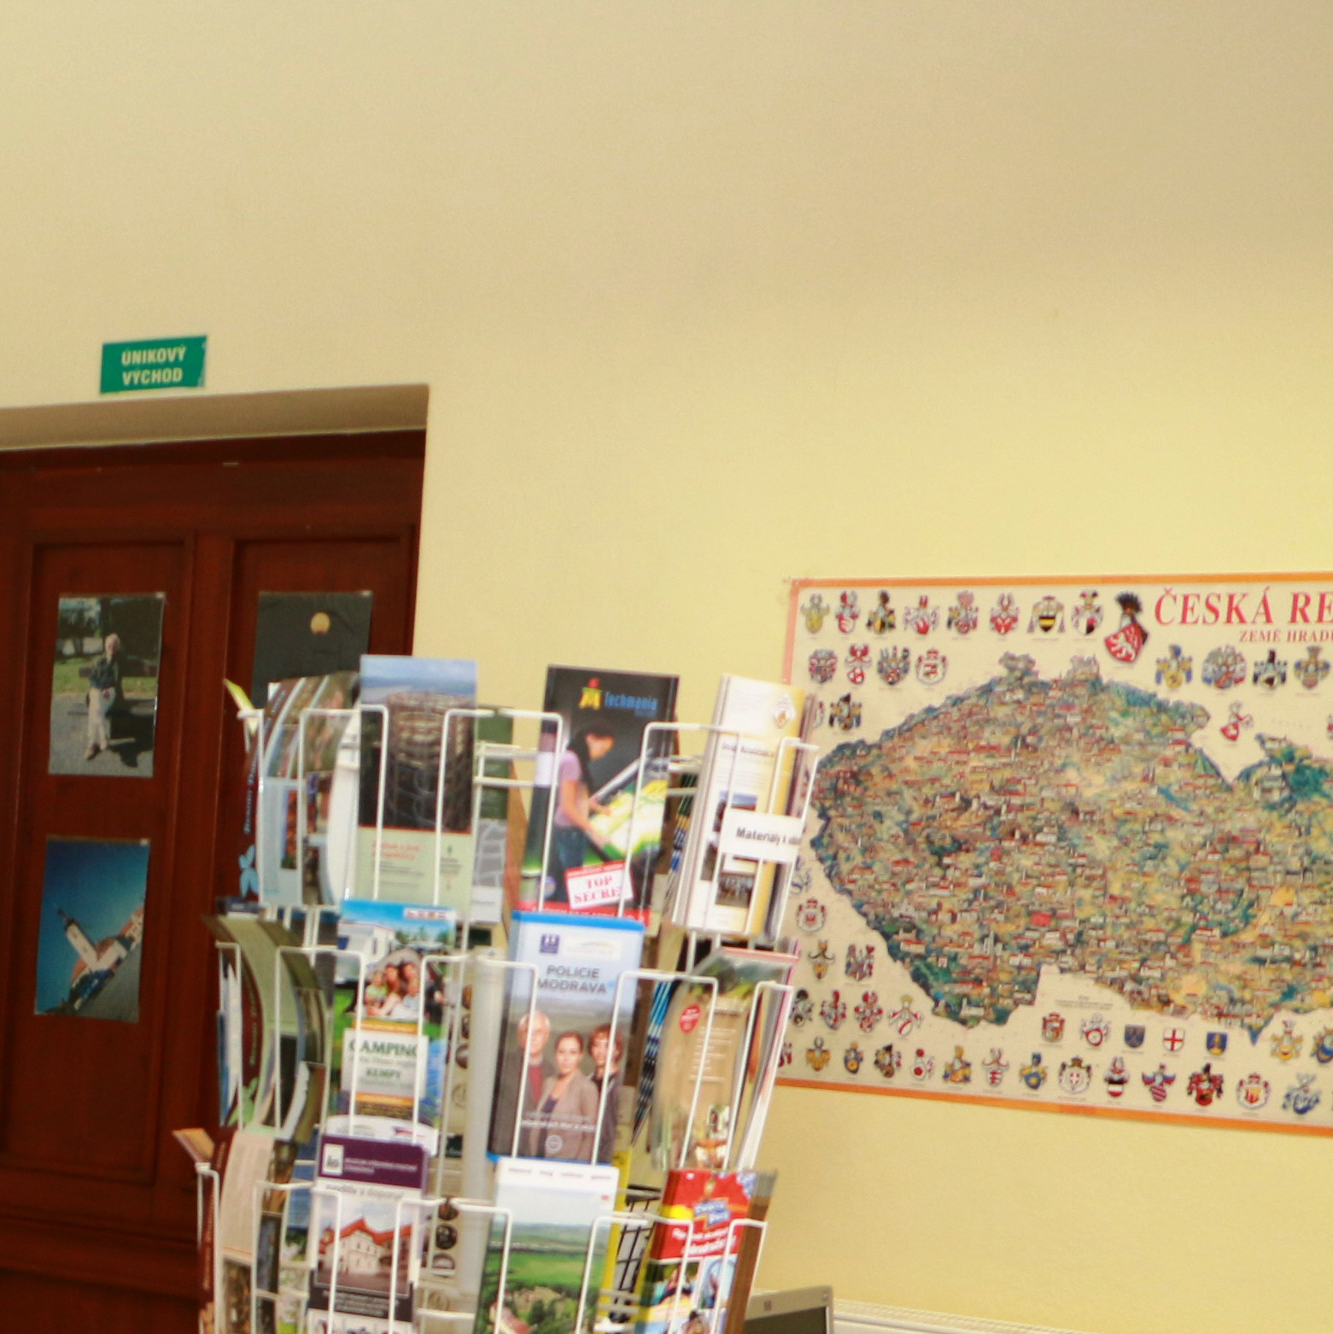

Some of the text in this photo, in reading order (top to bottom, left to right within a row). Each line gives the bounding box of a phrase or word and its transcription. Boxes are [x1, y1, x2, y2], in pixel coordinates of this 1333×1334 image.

[121, 344, 186, 366] ÚNIKOVÝ
[122, 366, 183, 386] VÝCHOD
[1154, 586, 1273, 626] ČESKÁ
[587, 875, 612, 889] TOP
[574, 886, 624, 904] SECRE
[547, 964, 600, 979] POLICIE
[537, 978, 607, 994] MODRAVA
